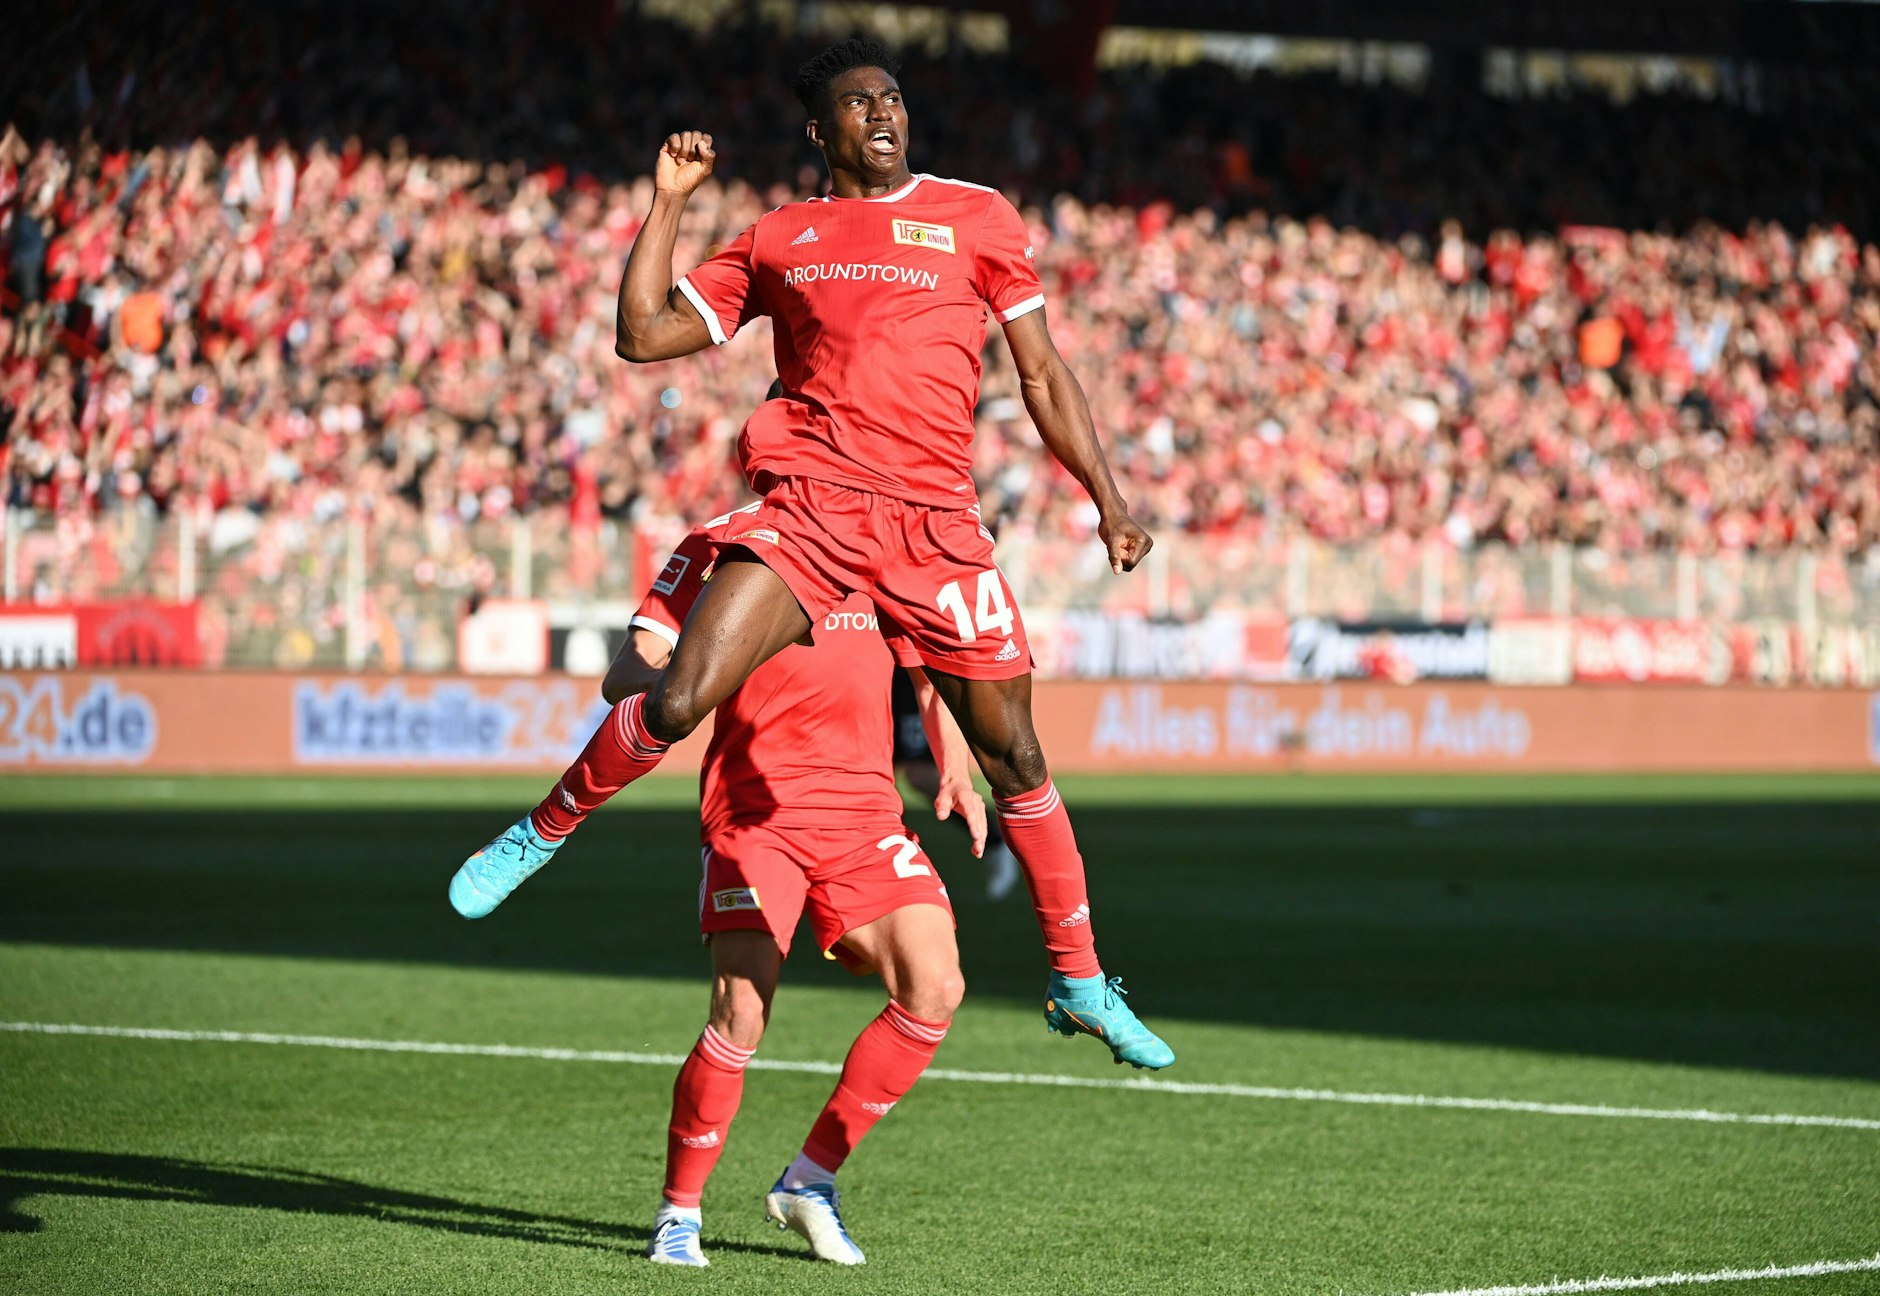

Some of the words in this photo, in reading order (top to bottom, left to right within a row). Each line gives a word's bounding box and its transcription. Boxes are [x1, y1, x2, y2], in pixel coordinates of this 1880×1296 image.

[927, 232, 950, 247] UNION
[784, 262, 940, 291] AROUNDTOWN
[935, 568, 1015, 644] 14
[825, 612, 880, 631] DTOW
[994, 649, 1021, 662] adidas
[295, 682, 602, 760] kfzteile24
[1092, 685, 1217, 757] Alles
[1226, 684, 1300, 757] für
[1305, 686, 1414, 757] dein
[1418, 691, 1532, 758] Auto
[1058, 912, 1090, 928] adida
